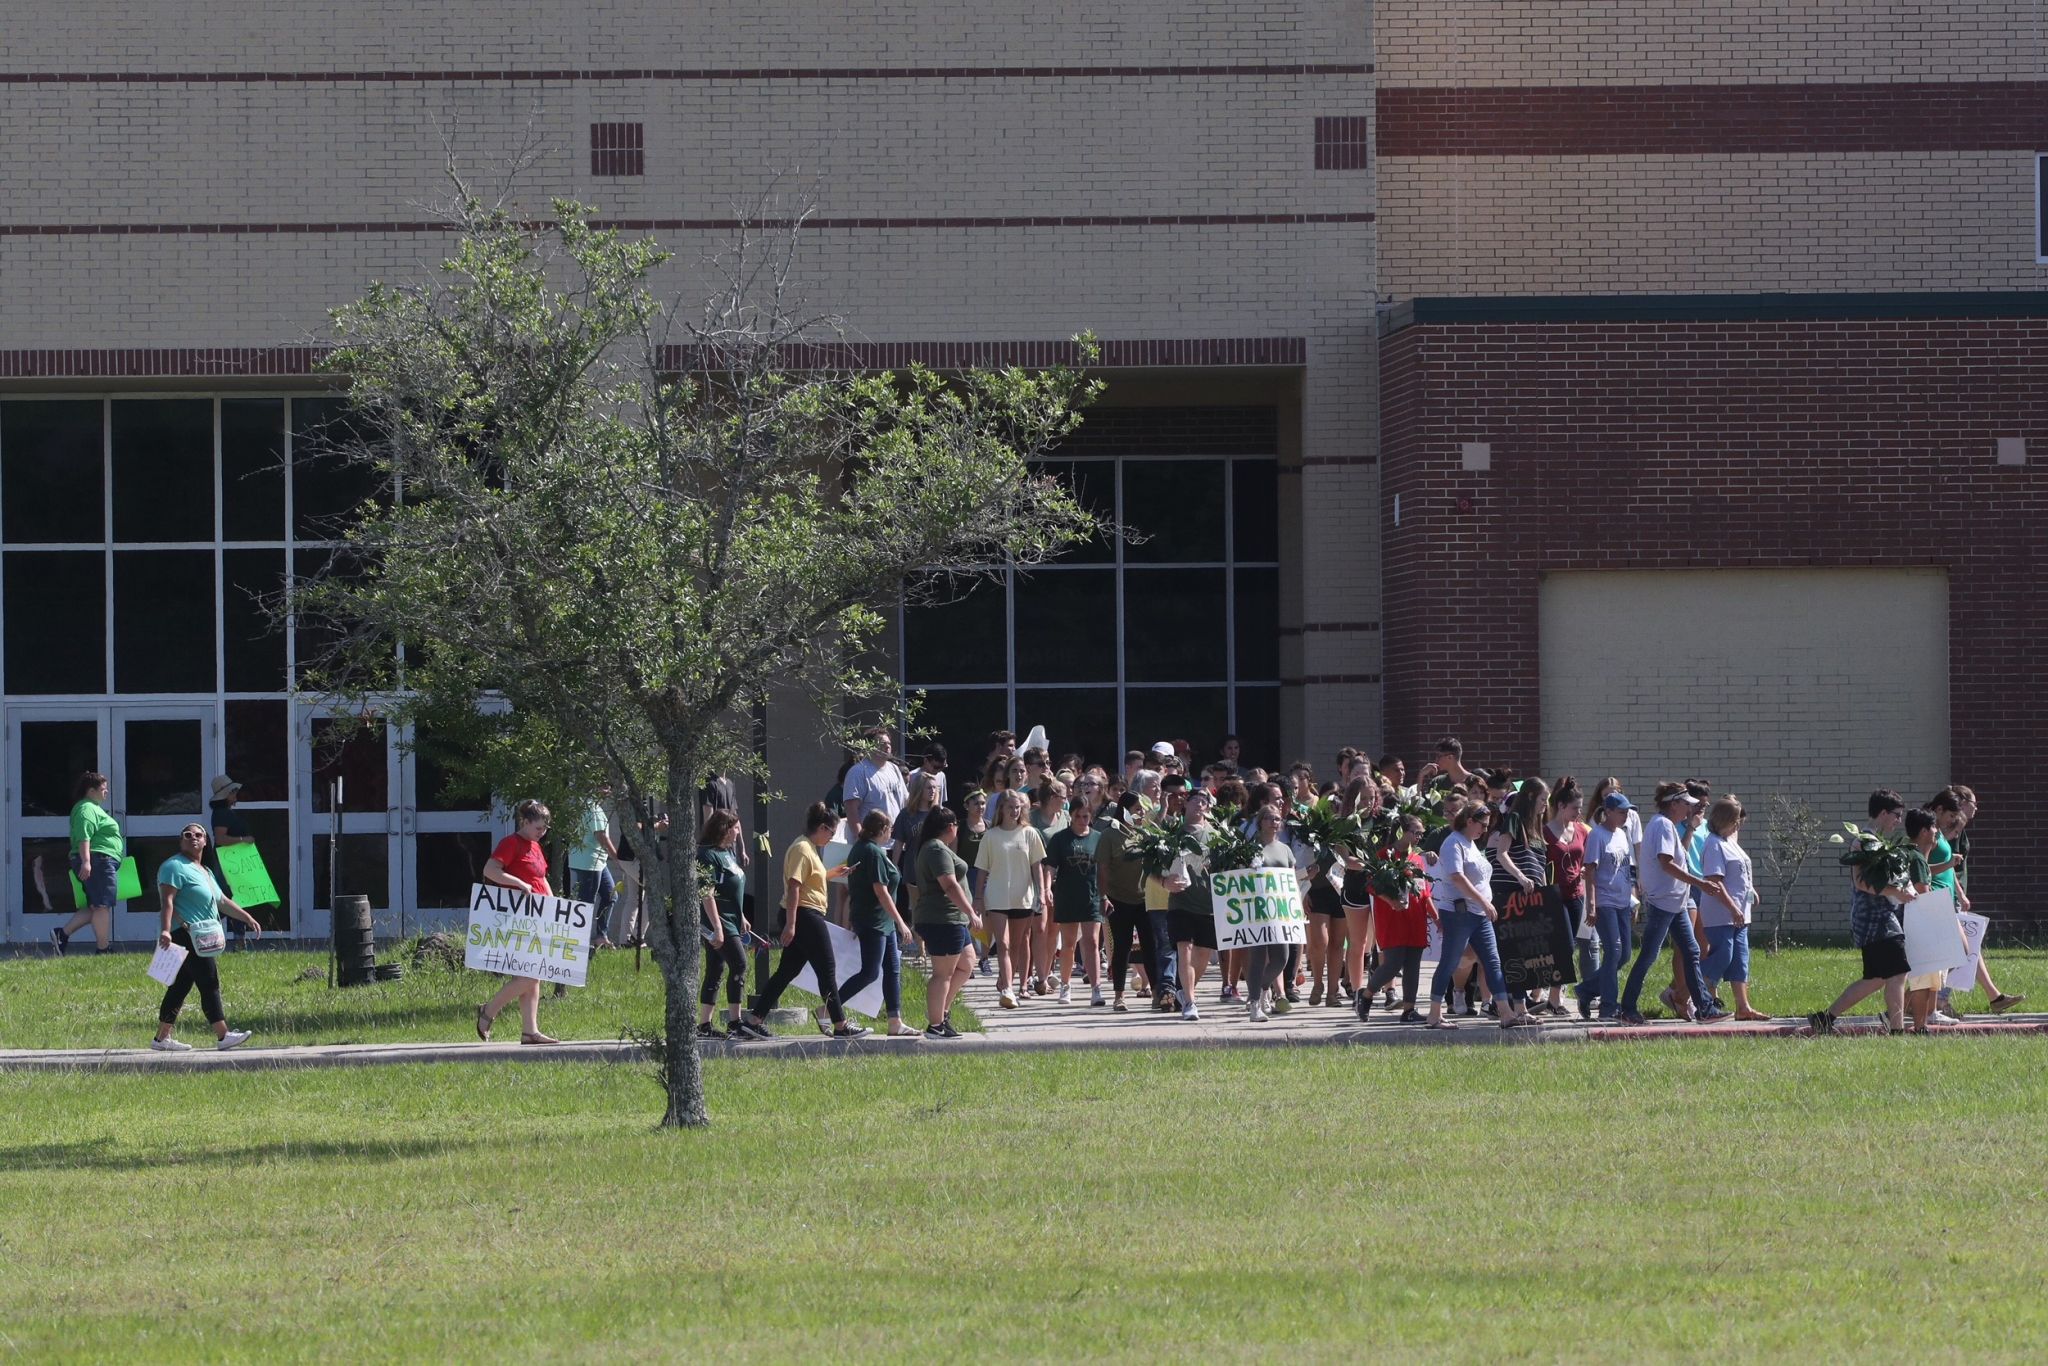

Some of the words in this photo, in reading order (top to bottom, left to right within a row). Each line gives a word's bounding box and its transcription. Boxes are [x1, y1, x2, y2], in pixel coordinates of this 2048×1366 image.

[1212, 871, 1278, 896] SANTA
[1279, 872, 1297, 893] FE
[473, 884, 545, 918] ALVIN
[555, 899, 586, 928] HS
[1226, 895, 1302, 925] STRONG
[1501, 890, 1544, 920] Alvin
[493, 912, 538, 932] STANDS
[543, 922, 570, 938] WITH
[1281, 925, 1300, 942] HS
[469, 923, 543, 955] SANTA
[548, 934, 579, 961] FE
